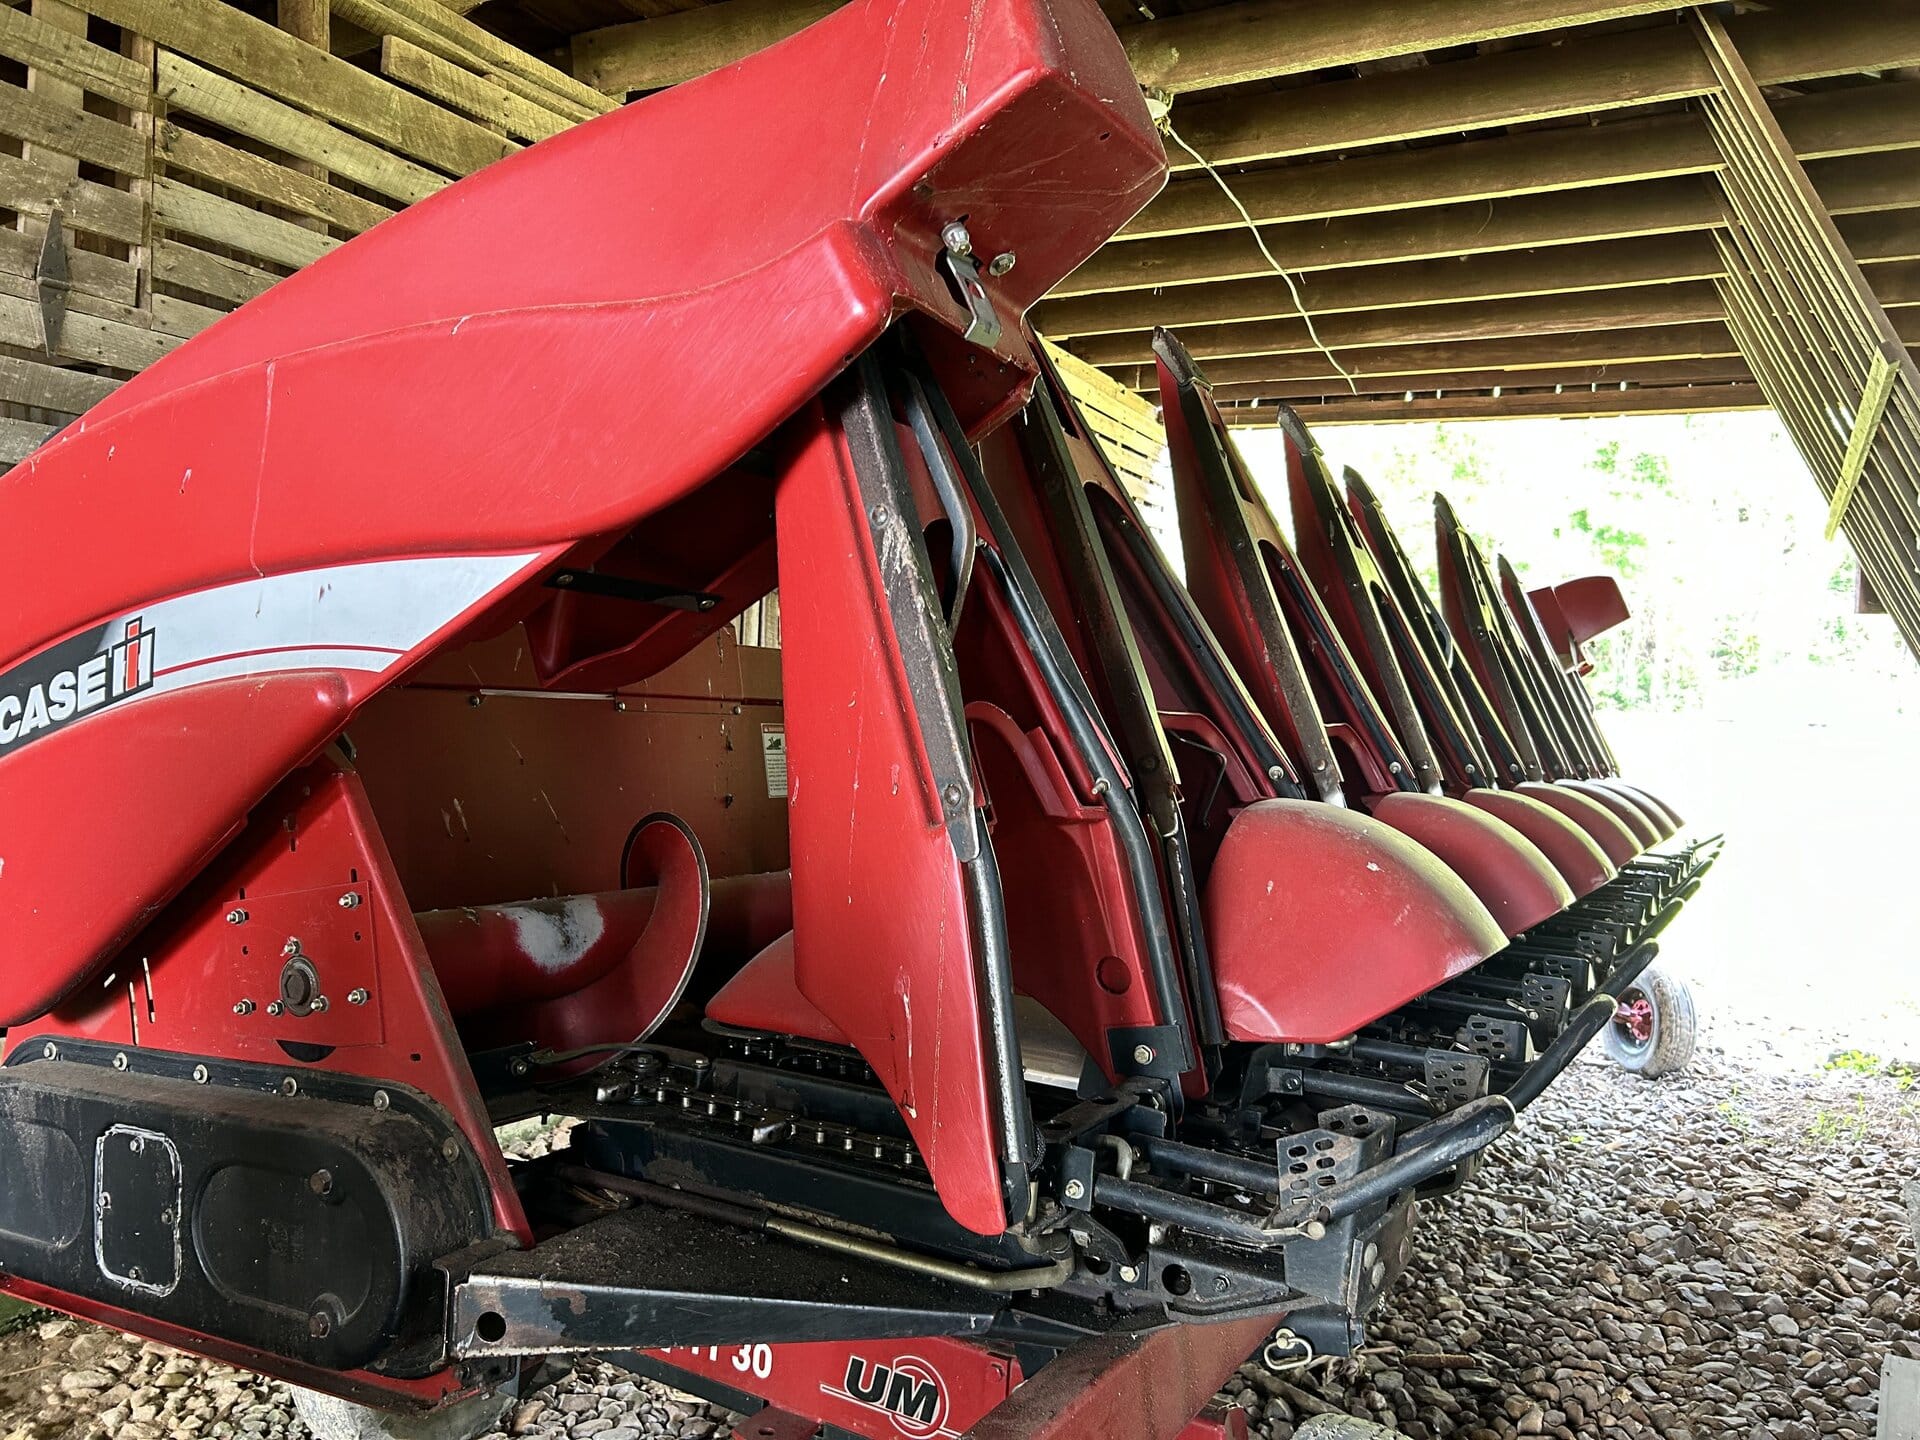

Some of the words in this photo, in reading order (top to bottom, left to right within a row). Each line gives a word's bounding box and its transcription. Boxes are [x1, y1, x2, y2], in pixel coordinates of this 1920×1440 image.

[0, 654, 107, 745] CASE
[731, 1343, 773, 1379] 30
[844, 1356, 940, 1425] UM
